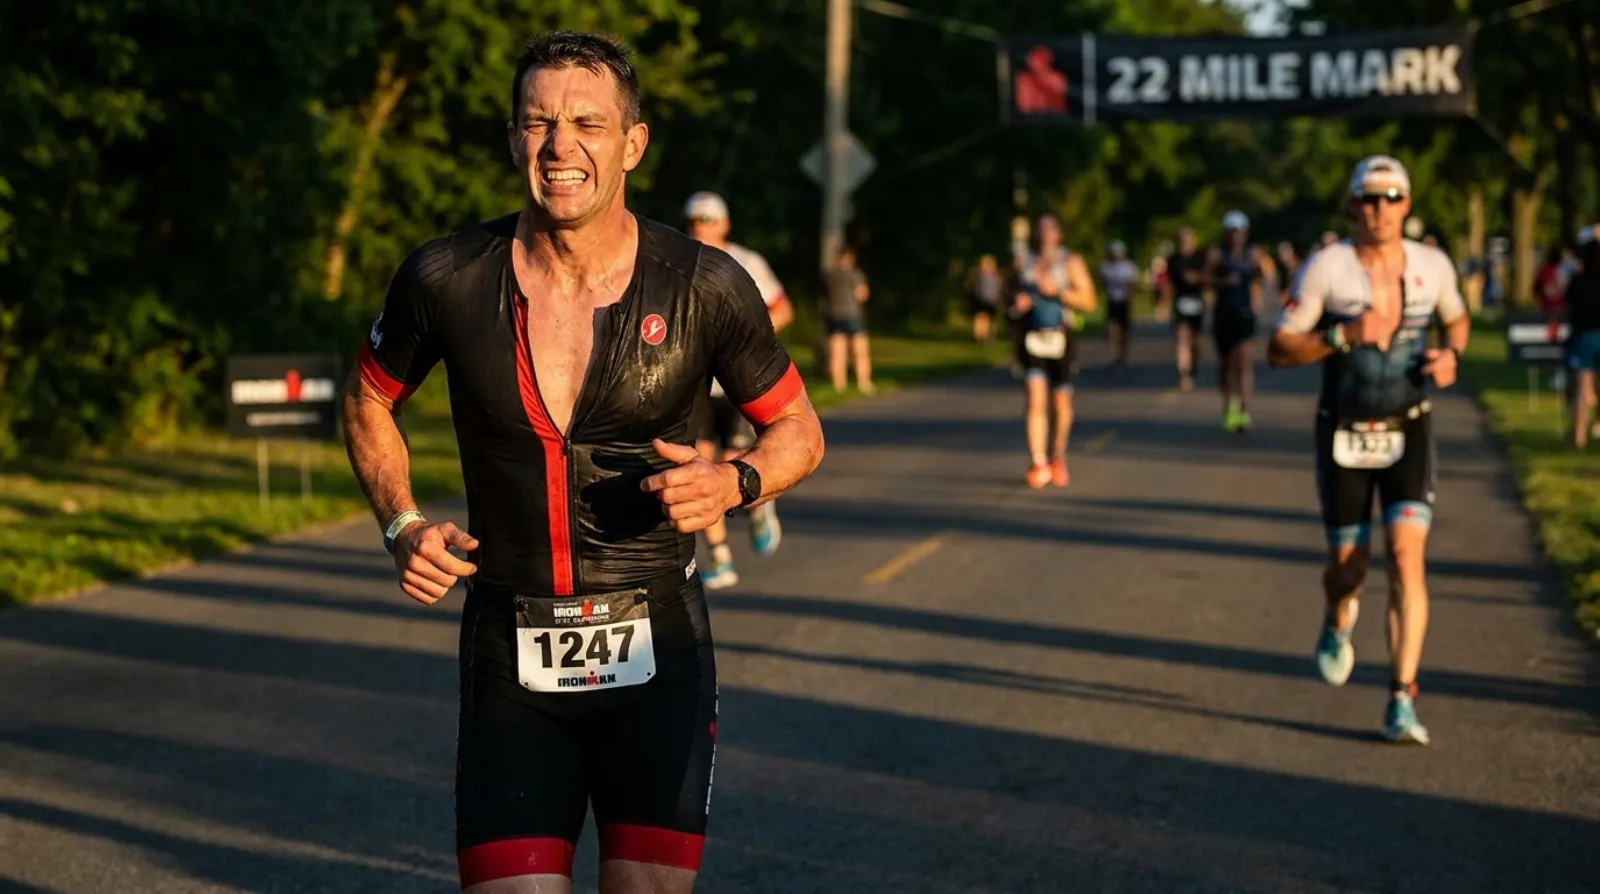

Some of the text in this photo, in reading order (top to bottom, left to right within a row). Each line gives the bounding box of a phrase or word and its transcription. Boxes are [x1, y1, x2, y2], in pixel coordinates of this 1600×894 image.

[1106, 45, 1461, 102] 22 MILE MARK
[533, 624, 635, 669] 1247
